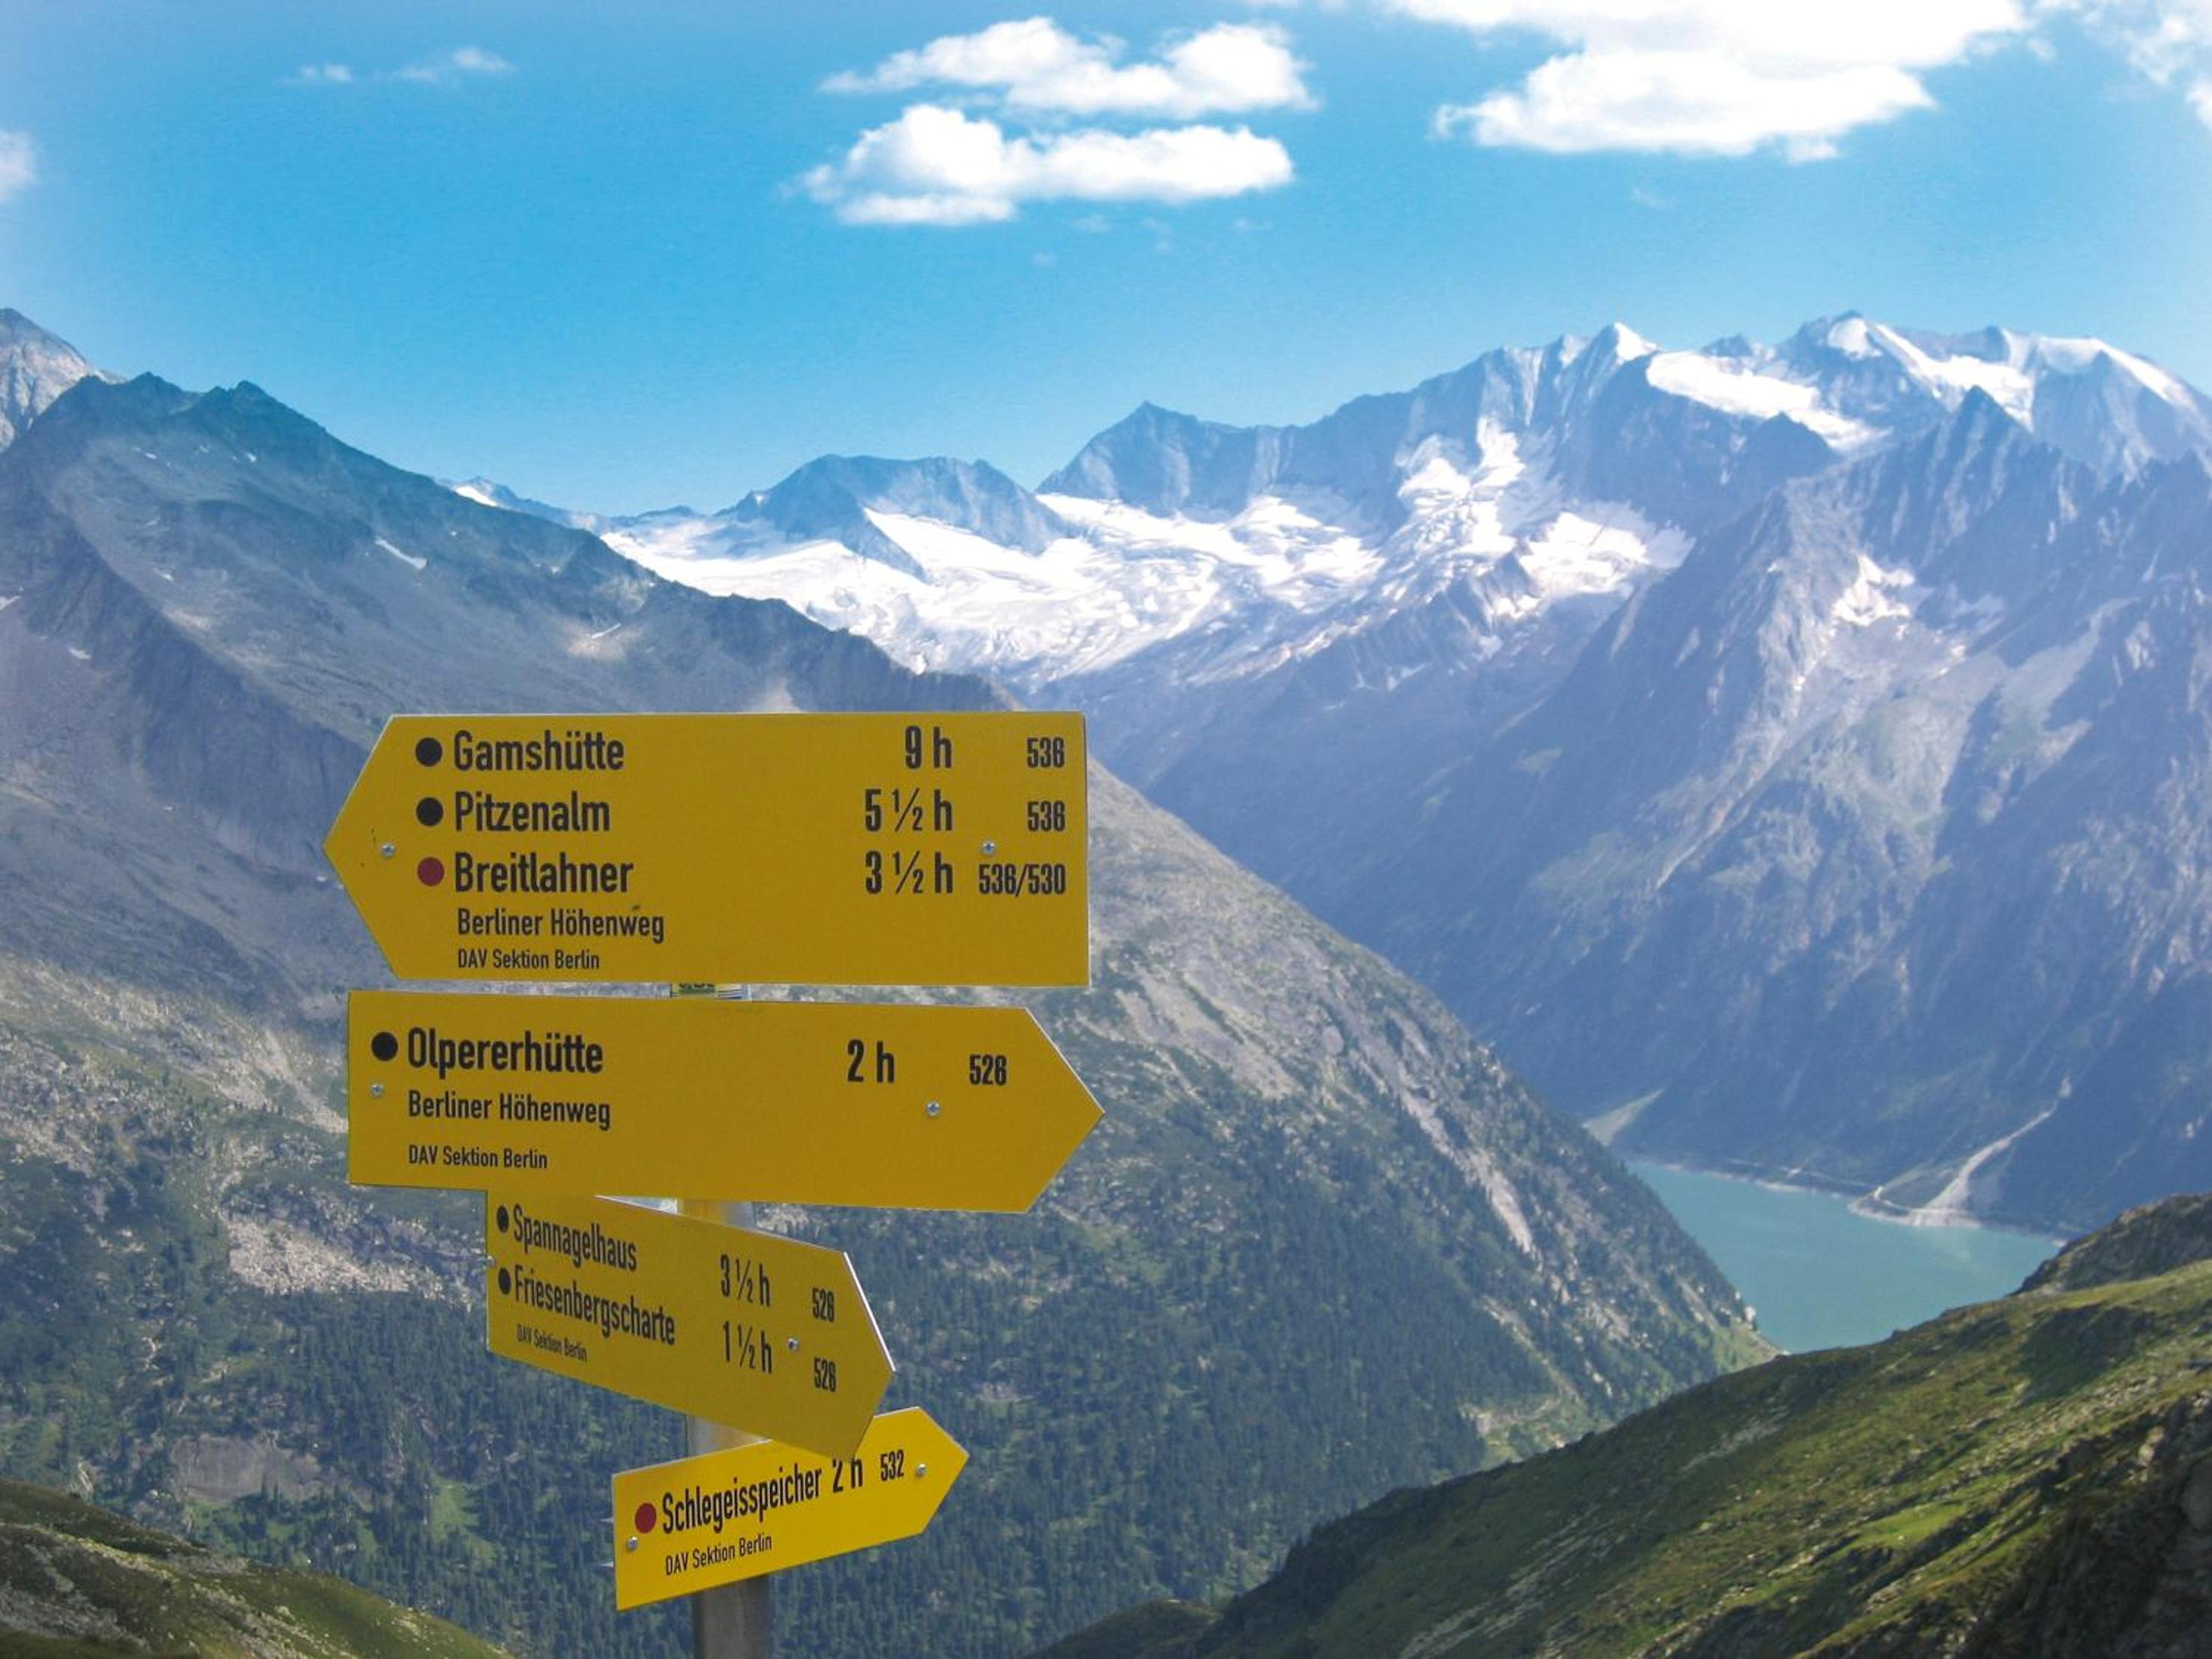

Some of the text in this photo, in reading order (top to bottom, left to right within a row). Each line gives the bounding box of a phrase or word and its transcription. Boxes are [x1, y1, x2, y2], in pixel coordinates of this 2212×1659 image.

[454, 730, 624, 771] Gamshütte
[905, 725, 922, 769] 9
[933, 726, 952, 768] h
[455, 790, 610, 832] Pitzenalm
[933, 789, 953, 831] h
[455, 852, 633, 894] Breitlahner
[934, 852, 954, 894] h
[978, 863, 1066, 897] 536/530
[458, 908, 664, 944] Berliner Höhenweg
[458, 948, 600, 970] DAV Sektion Berlin
[407, 1027, 603, 1080] Olpererhütte
[847, 1039, 864, 1082] 2
[876, 1040, 894, 1084] h
[408, 1089, 610, 1132] Berliner Höhenweg
[408, 1144, 548, 1169] DAV Sektion Berlin
[513, 1204, 637, 1272] Spannagelhaus
[759, 1264, 770, 1307] h
[514, 1264, 675, 1345] Friesenbergscharte
[760, 1330, 772, 1374] h
[662, 1464, 822, 1535] Schlegeisspeicher
[880, 1449, 904, 1481] 532
[665, 1533, 772, 1576] DAV Sektion Berlin
